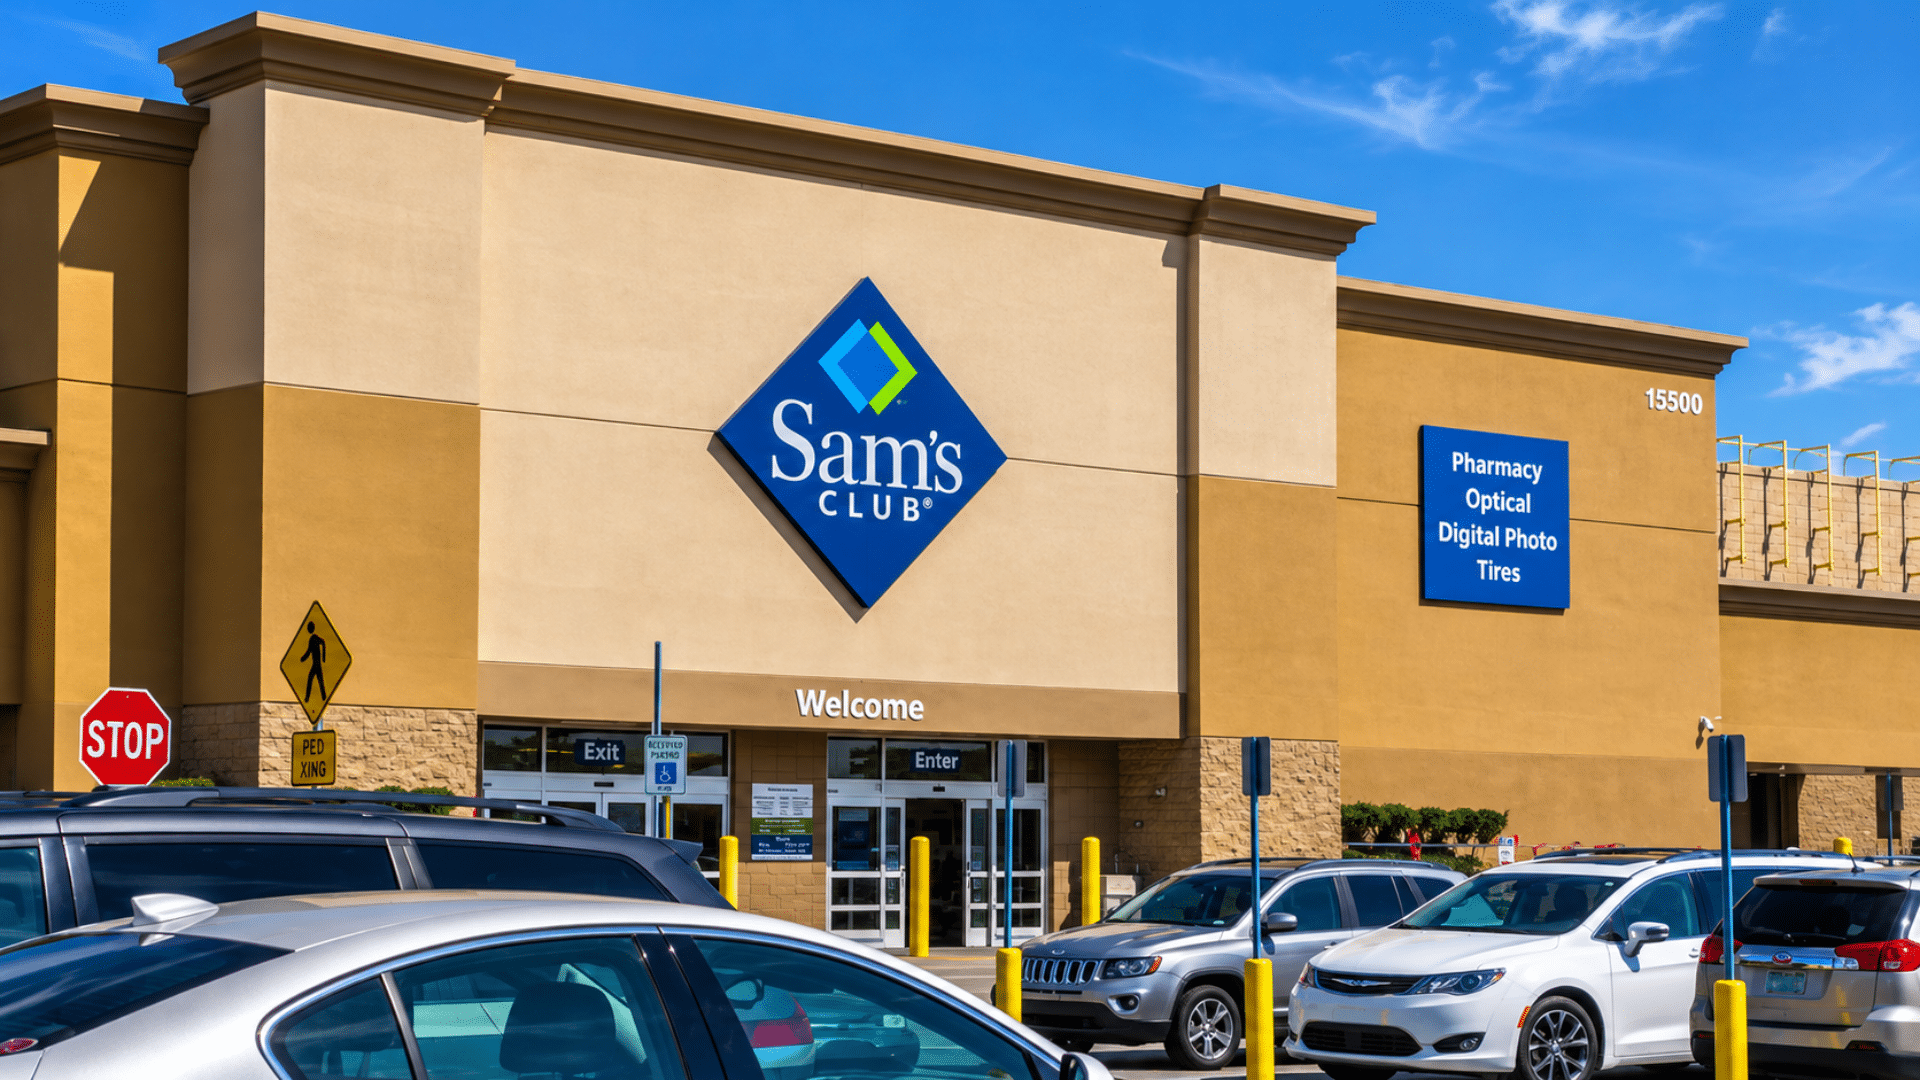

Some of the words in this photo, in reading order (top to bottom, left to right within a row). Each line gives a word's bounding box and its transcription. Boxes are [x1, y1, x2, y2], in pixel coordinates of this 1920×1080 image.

[1645, 388, 1703, 415] 15500
[771, 399, 963, 494] Sam's
[1452, 452, 1543, 485] Pharmacy
[1465, 488, 1531, 515] Optical
[1438, 521, 1500, 549] Digital
[1505, 527, 1558, 551] Photo
[1476, 559, 1521, 582] Tires
[796, 689, 924, 720] Welcome
[86, 719, 164, 760] STOP
[302, 738, 325, 756] PED
[584, 742, 620, 761] Exit
[300, 760, 327, 778] XING
[915, 751, 959, 769] Enter
